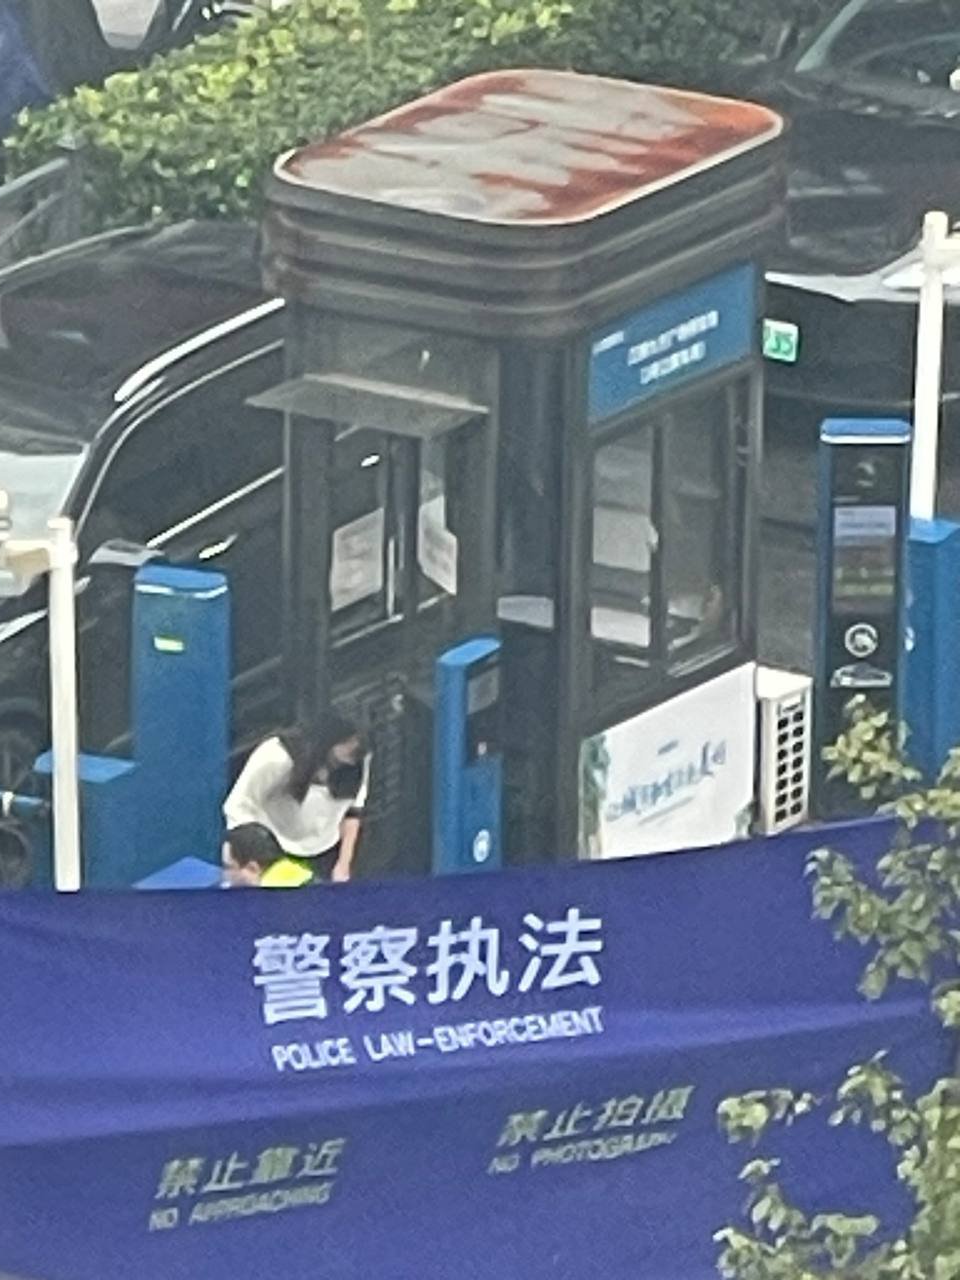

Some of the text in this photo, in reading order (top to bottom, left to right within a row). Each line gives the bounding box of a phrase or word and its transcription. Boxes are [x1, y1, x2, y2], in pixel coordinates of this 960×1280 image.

[253, 908, 603, 1025] 警察执法
[271, 1006, 604, 1072] POLICE LAW-ENFORCEMENT
[155, 1138, 347, 1198] 禁止靠近
[488, 1153, 521, 1174] NO
[150, 1206, 178, 1231] NO
